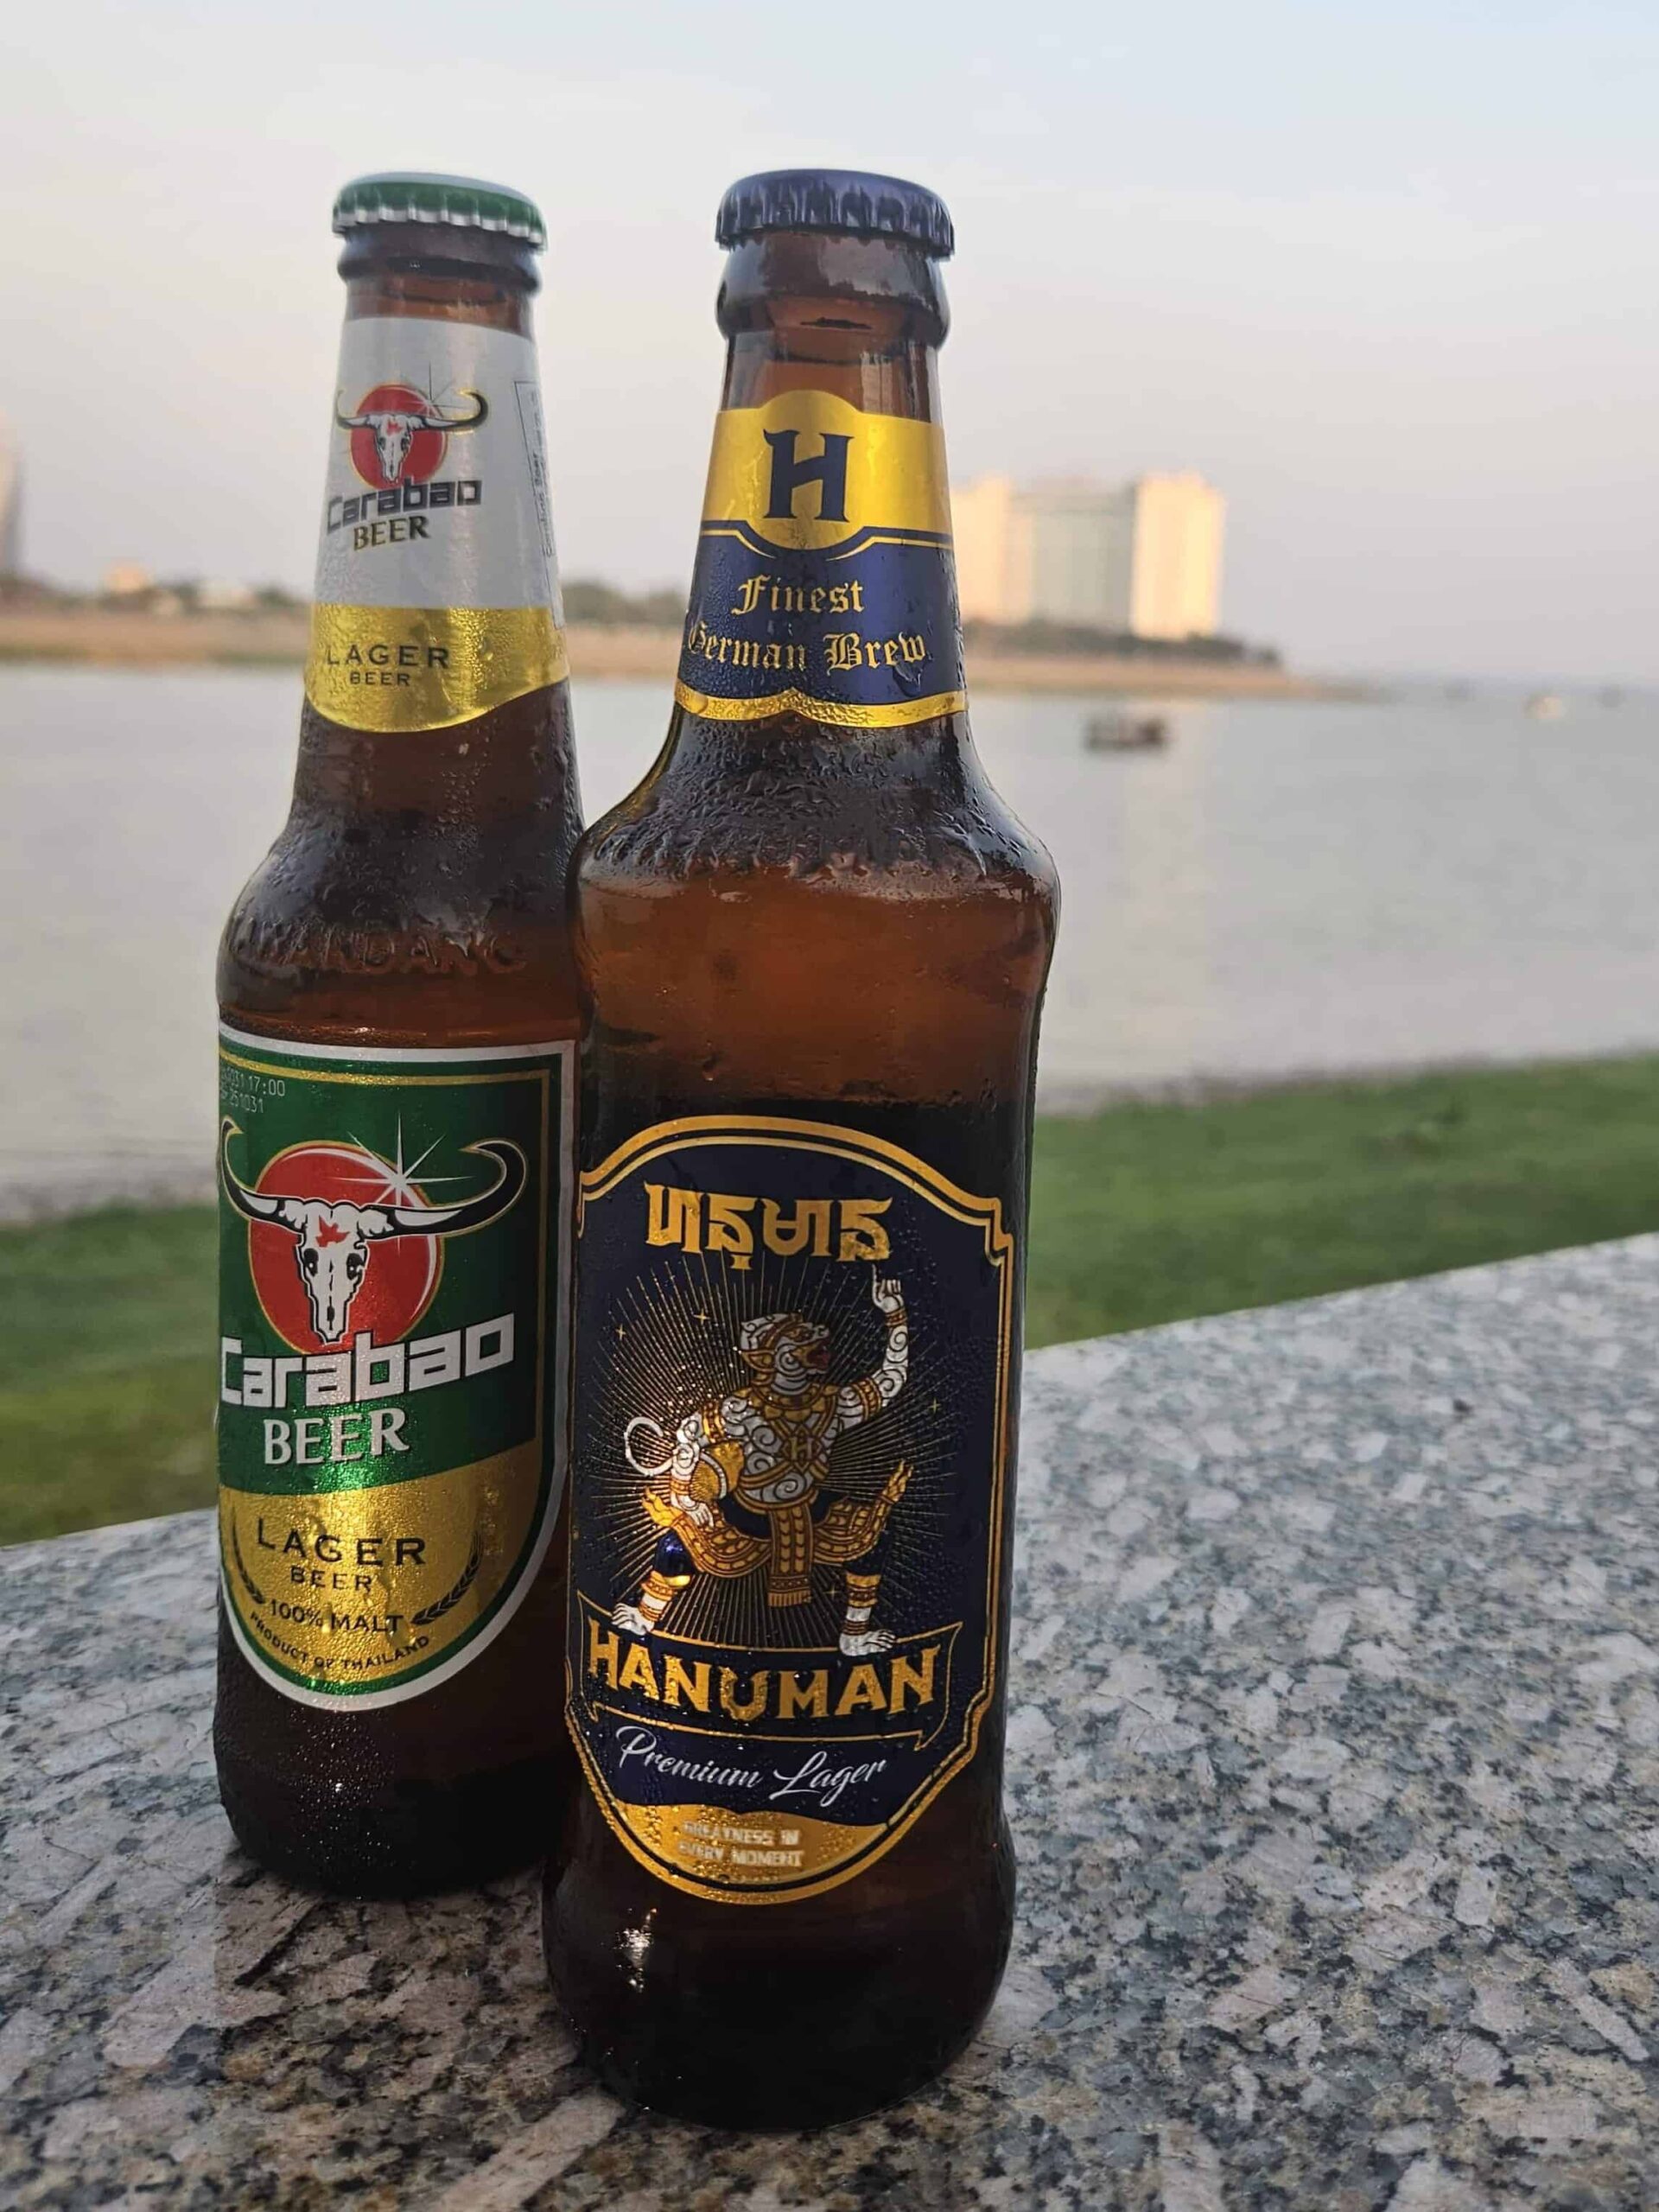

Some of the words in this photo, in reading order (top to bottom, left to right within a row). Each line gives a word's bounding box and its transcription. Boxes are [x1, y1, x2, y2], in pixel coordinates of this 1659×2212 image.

[762, 428, 855, 524] H
[327, 476, 483, 535] Carabao
[353, 515, 431, 552] BEER
[731, 574, 865, 616] Finest
[326, 644, 450, 669] LAGER
[687, 620, 807, 671] German
[823, 630, 928, 677] Brew
[349, 671, 411, 688] BEER
[248, 1075, 286, 1096] 17:00
[643, 1180, 894, 1270] ហនុមាន
[220, 1313, 515, 1408] Carabao
[263, 1408, 413, 1466] BEER
[257, 1517, 427, 1567] LAGER
[290, 1566, 373, 1593] BEER
[250, 1611, 308, 1664] PRODUCT
[314, 1656, 334, 1669] OF
[340, 1636, 430, 1670] THAILAND
[270, 1599, 323, 1628] 100%
[330, 1613, 404, 1633] MALT
[586, 1616, 942, 1722] HANUMAN
[615, 1725, 766, 1789] Premium
[769, 1750, 888, 1808] Lager
[730, 1847, 805, 1867] MOMENT
